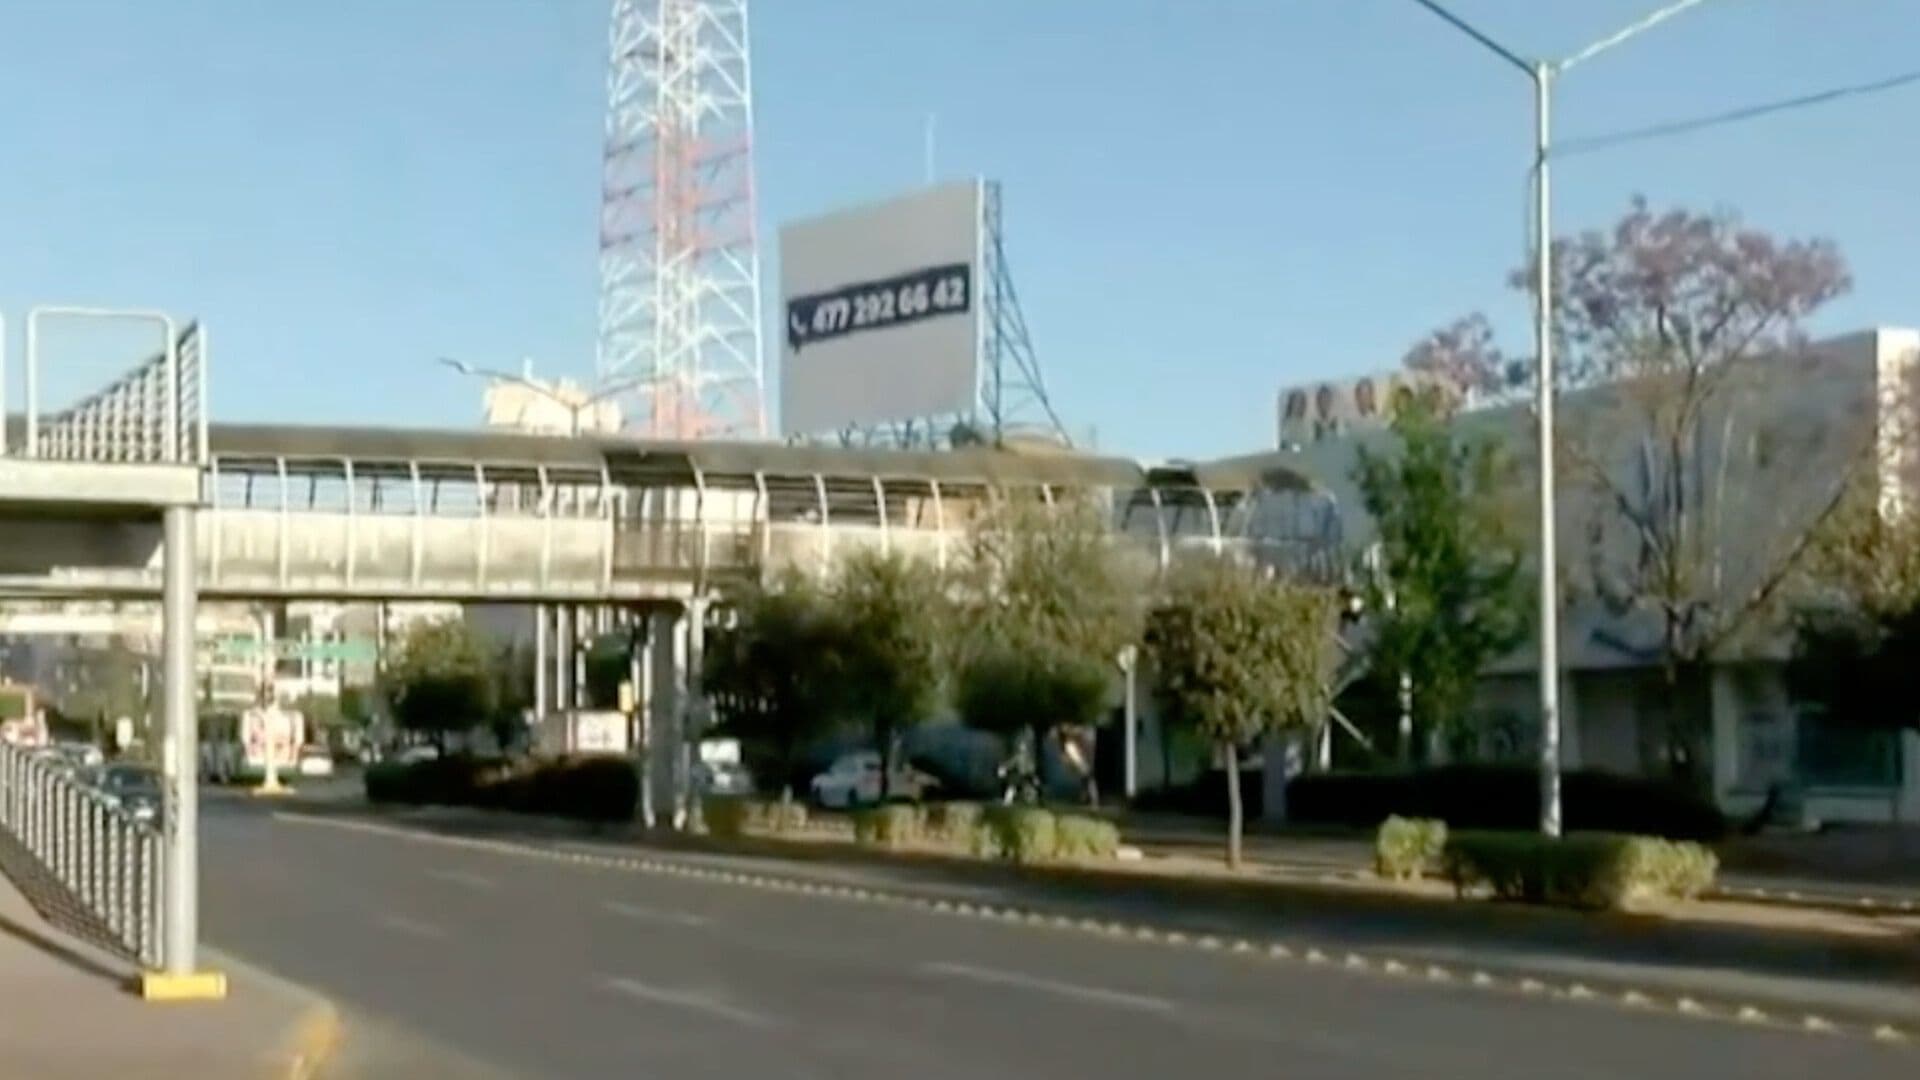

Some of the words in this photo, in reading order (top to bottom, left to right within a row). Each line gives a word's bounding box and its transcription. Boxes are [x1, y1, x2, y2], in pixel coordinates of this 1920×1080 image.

[812, 299, 850, 332] 477
[853, 290, 895, 326] 292
[932, 276, 964, 306] 42
